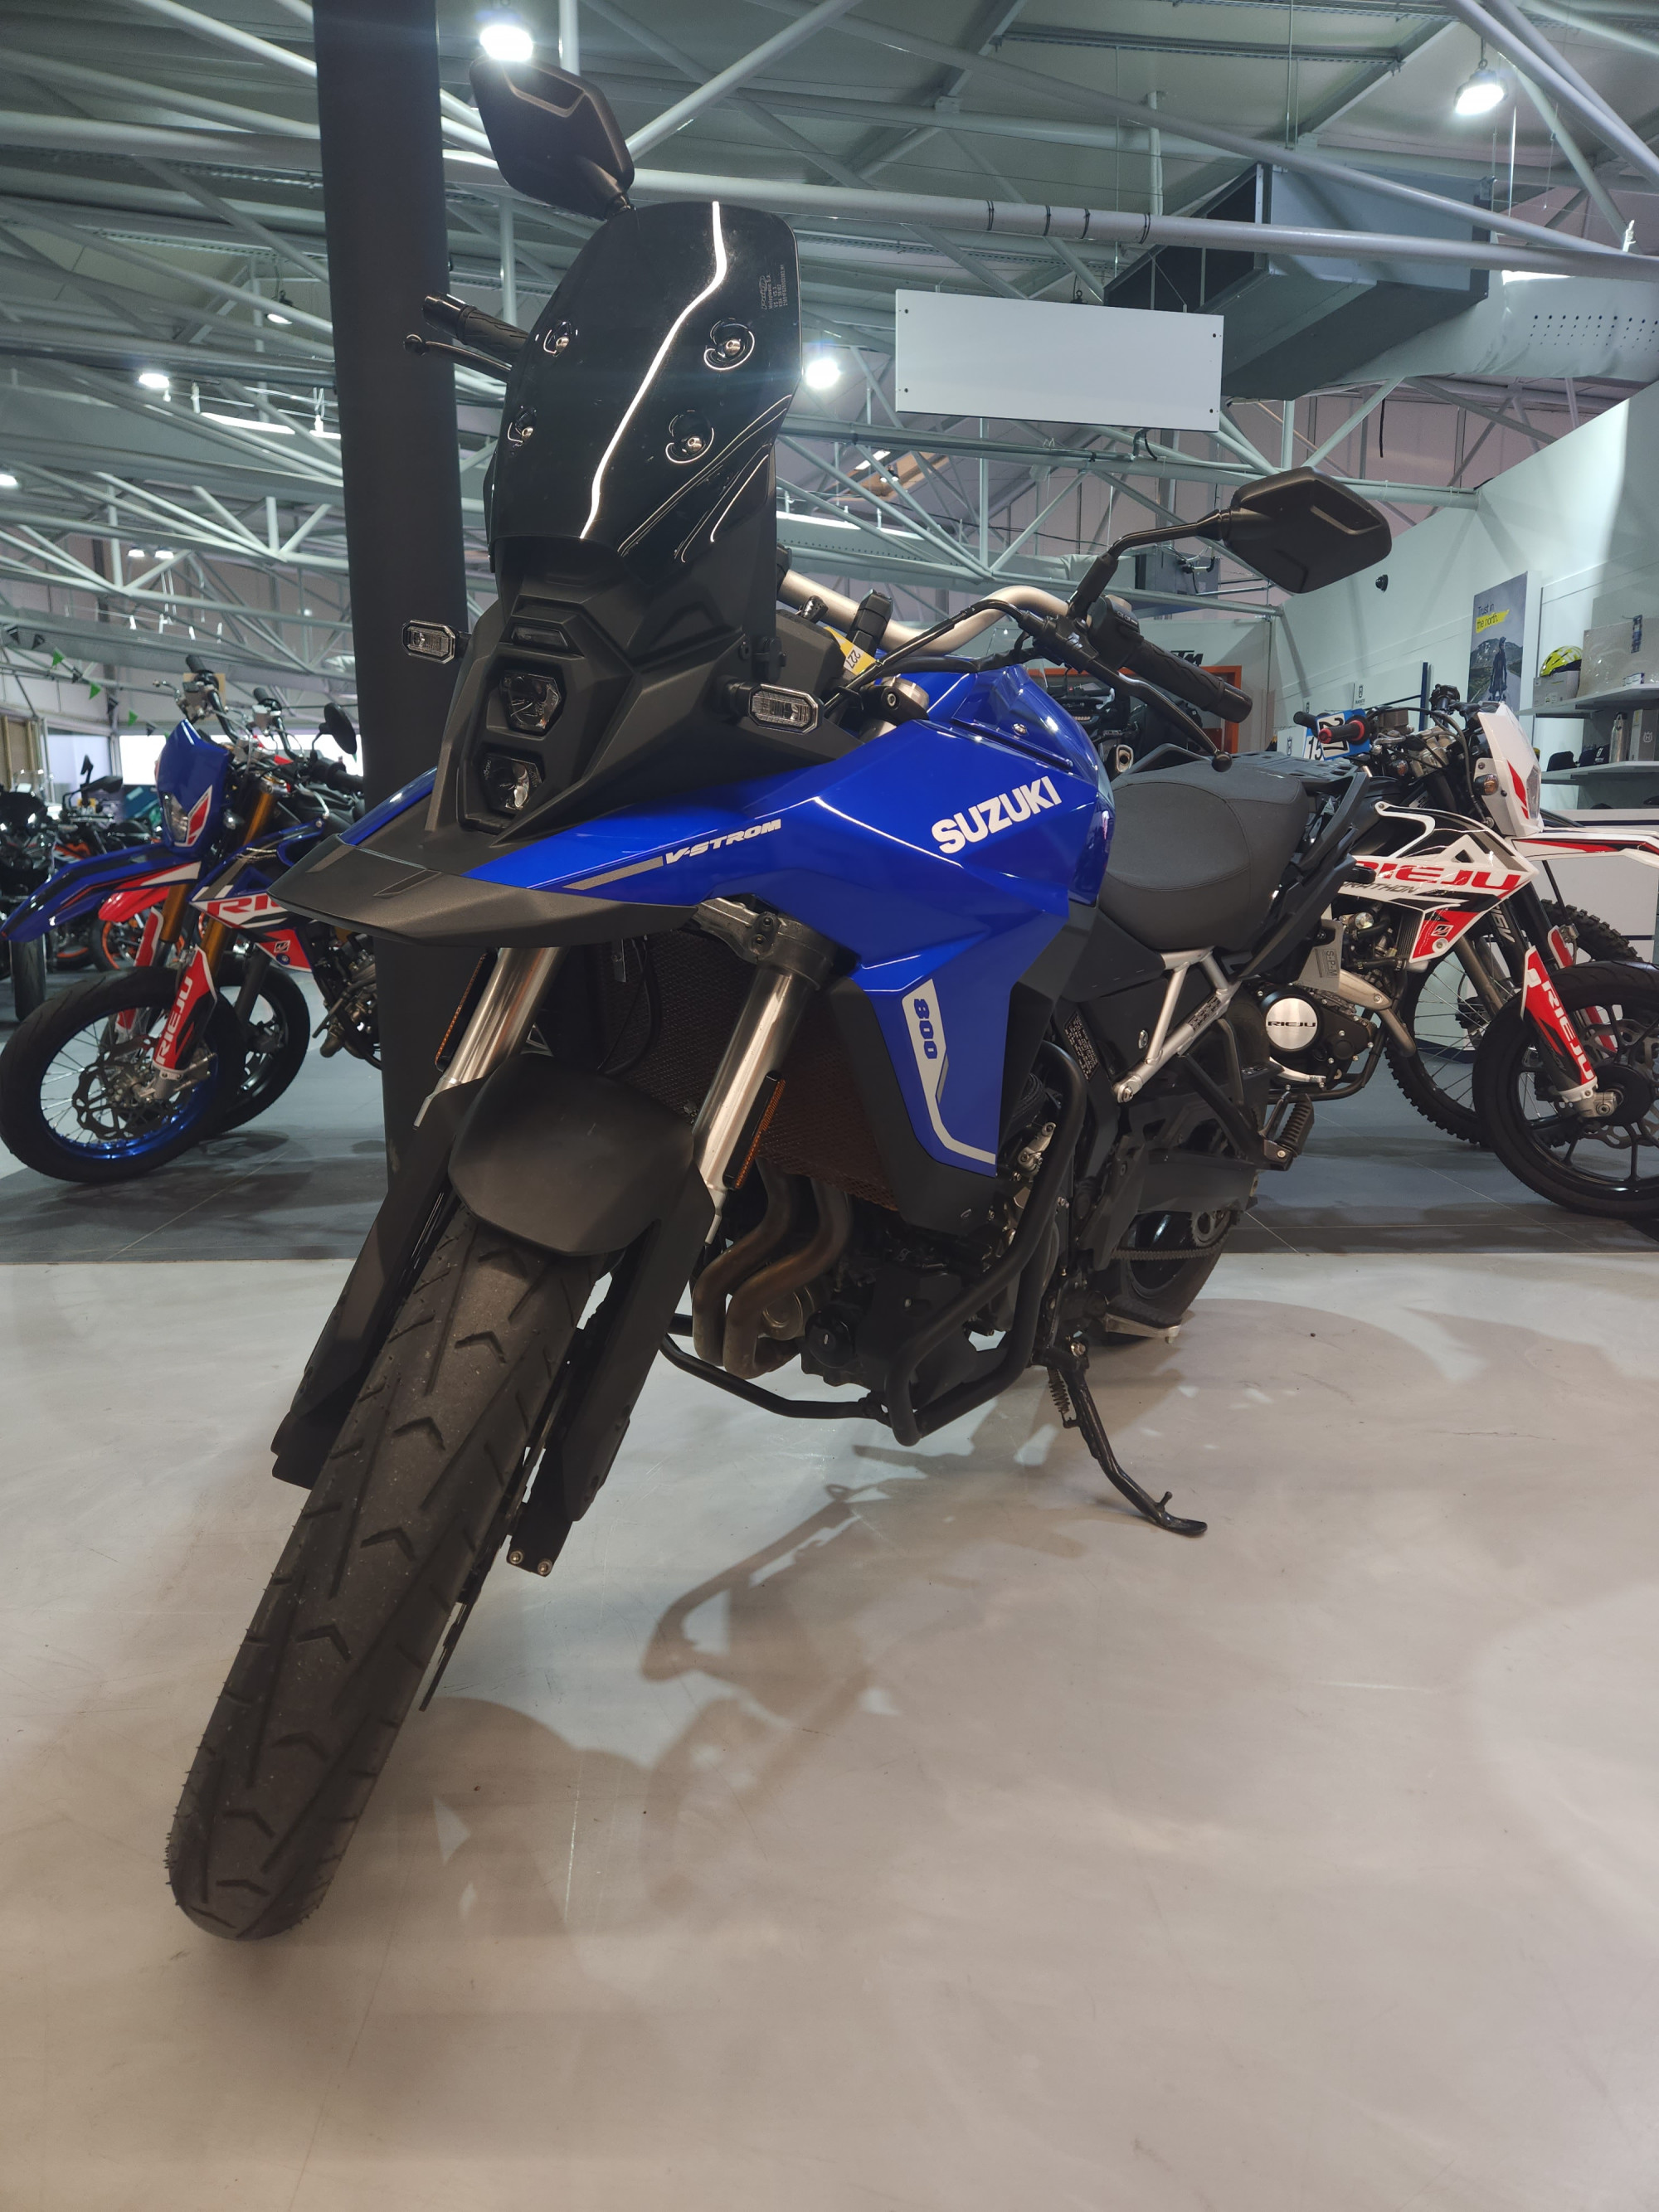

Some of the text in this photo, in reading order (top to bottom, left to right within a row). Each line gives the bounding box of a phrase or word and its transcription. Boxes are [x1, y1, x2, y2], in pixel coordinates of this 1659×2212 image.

[845, 649, 861, 669] 227
[1170, 650, 1204, 667] TM
[665, 819, 781, 864] V-STROM
[932, 775, 1063, 853] SUZUKI
[155, 975, 193, 1065] RIEJU
[913, 999, 938, 1059] 800
[1541, 980, 1595, 1081] RIEJU
